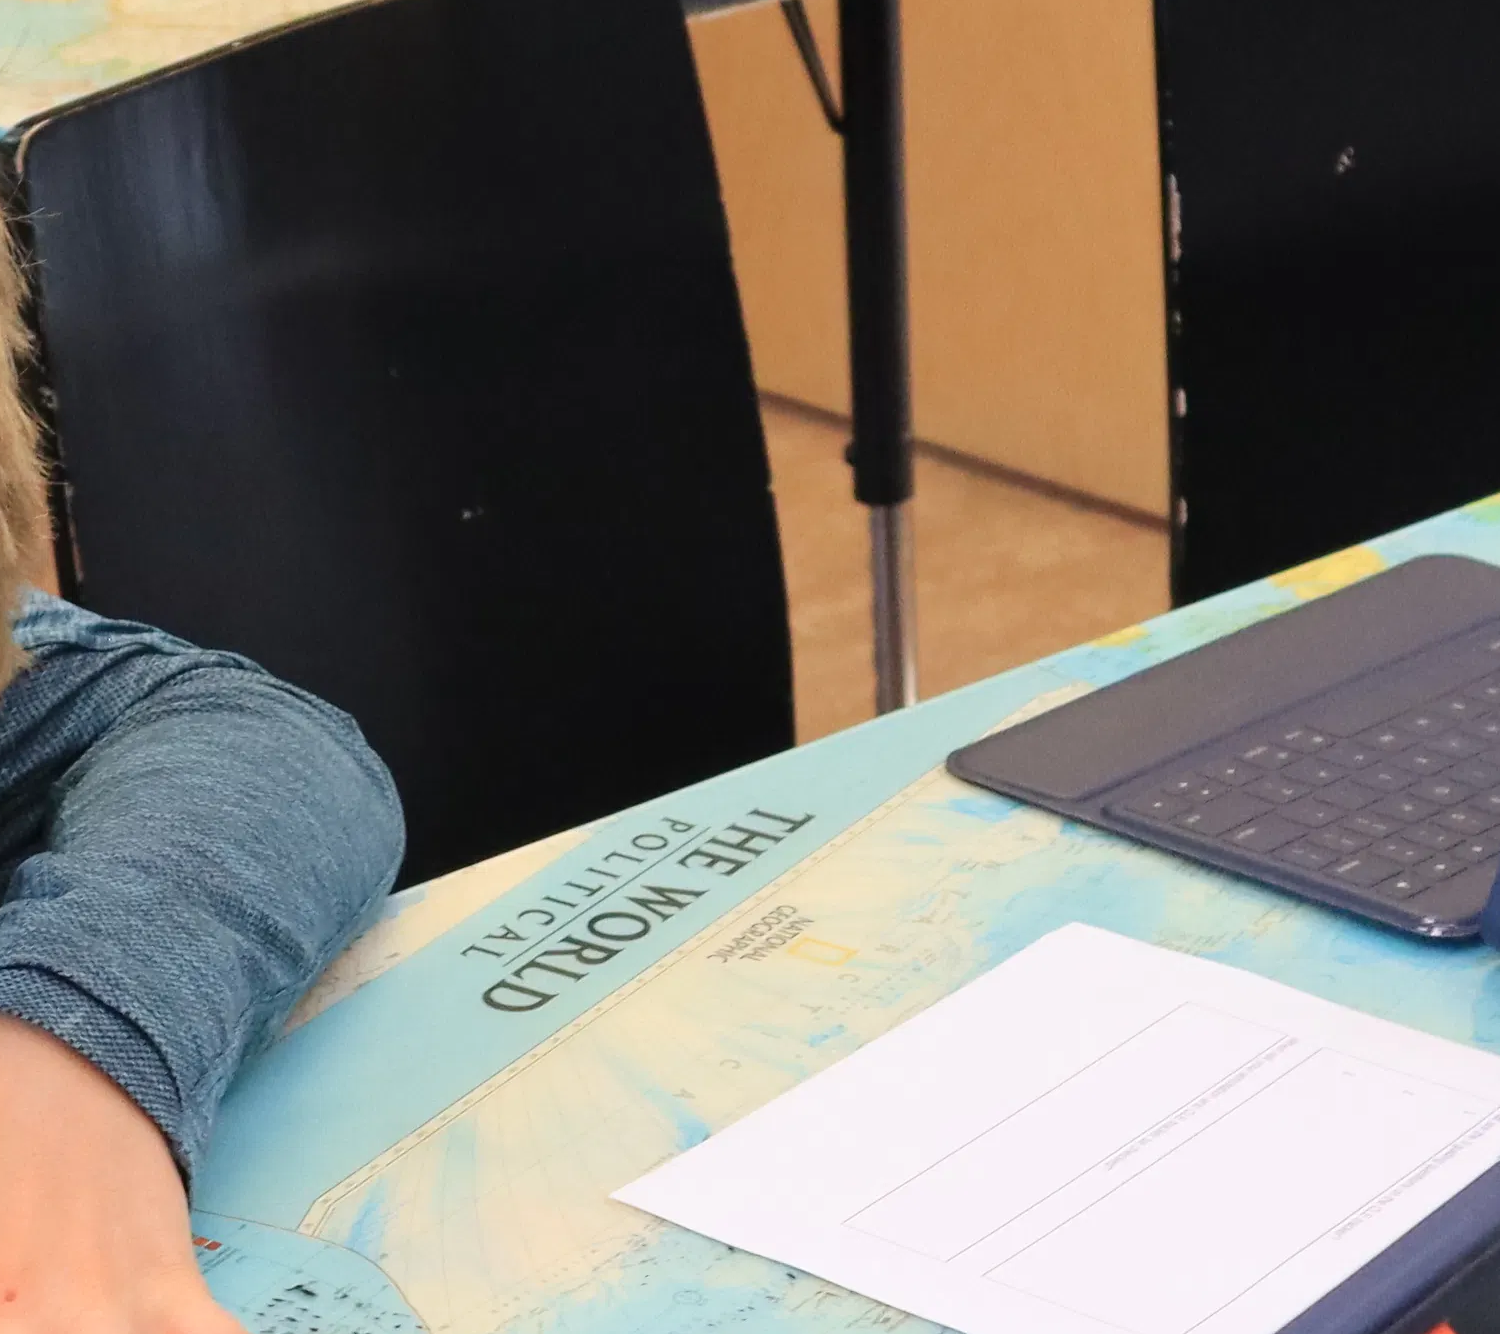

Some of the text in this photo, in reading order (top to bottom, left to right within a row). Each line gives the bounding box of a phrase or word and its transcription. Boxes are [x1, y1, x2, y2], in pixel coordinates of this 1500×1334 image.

[461, 817, 695, 958] POLITICAL
[481, 808, 815, 1013] THE WORLD
[706, 904, 797, 963] GEOGRAPHIC
[740, 917, 813, 961] NATIONAL
